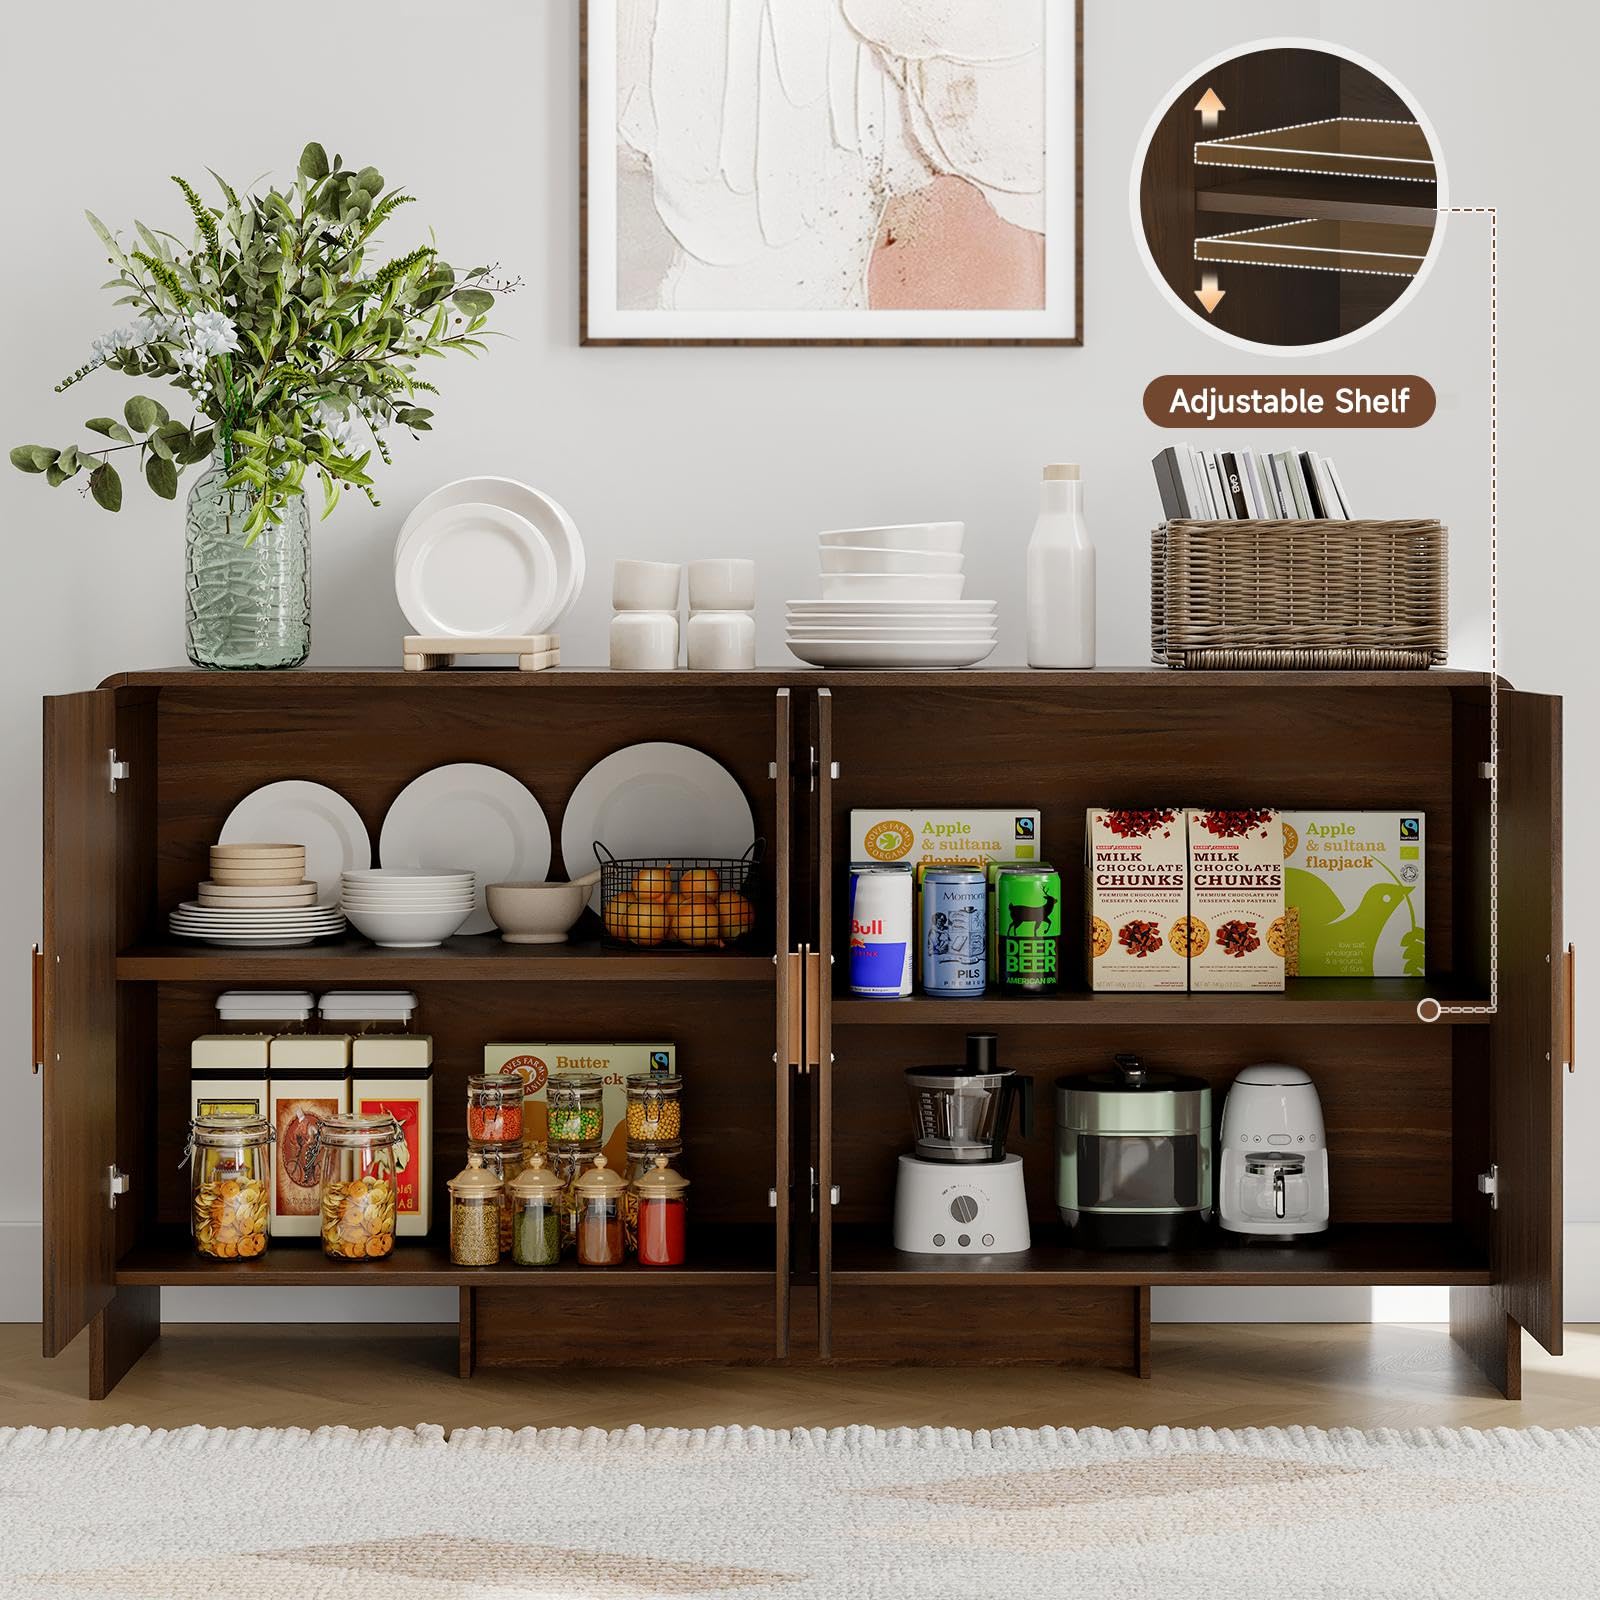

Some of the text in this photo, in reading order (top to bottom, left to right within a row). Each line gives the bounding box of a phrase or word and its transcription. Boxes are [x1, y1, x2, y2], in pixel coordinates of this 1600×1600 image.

[921, 821, 971, 837] Apple
[1306, 822, 1356, 838] Apple
[922, 839, 1002, 850] & sultana
[1306, 840, 1386, 852] & sultana
[1097, 853, 1142, 861] MILK
[1194, 853, 1239, 861] MILK
[1306, 856, 1374, 872] flapjack
[1097, 875, 1183, 885] CHUNKS
[1194, 875, 1281, 885] CHUNKS
[852, 919, 882, 935] Bull
[1006, 939, 1057, 956] DEER
[1006, 956, 1057, 973] BEER
[958, 969, 980, 979] PILS
[1007, 977, 1057, 985] AMERICAN IPA
[556, 1056, 610, 1069] Butter
